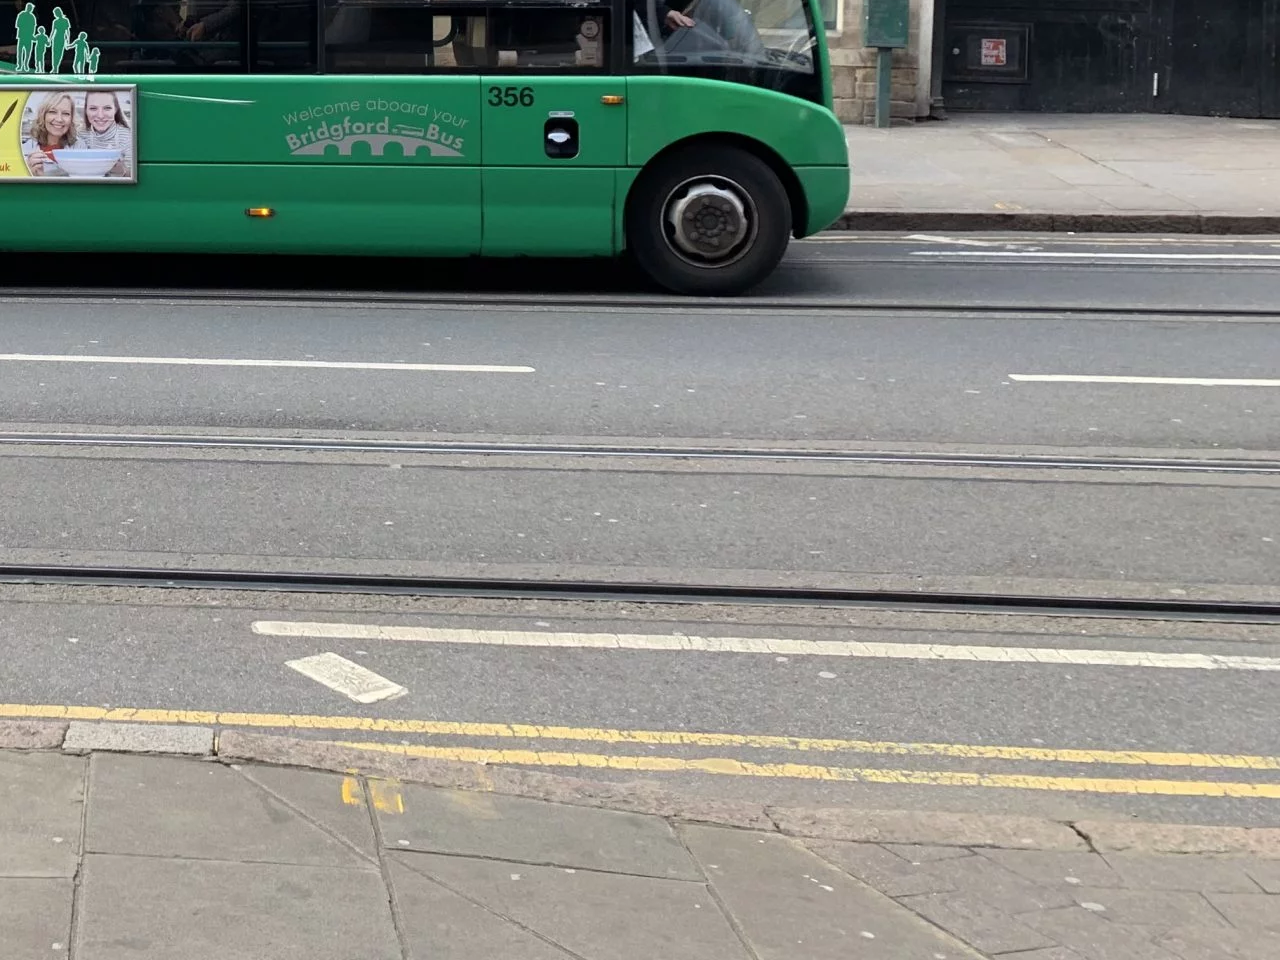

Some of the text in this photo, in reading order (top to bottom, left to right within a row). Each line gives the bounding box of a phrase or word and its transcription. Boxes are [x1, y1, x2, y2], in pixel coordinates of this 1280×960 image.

[487, 86, 535, 107] 356
[282, 98, 470, 129] Welcome aboard your
[284, 116, 466, 151] Bridgford Bus
